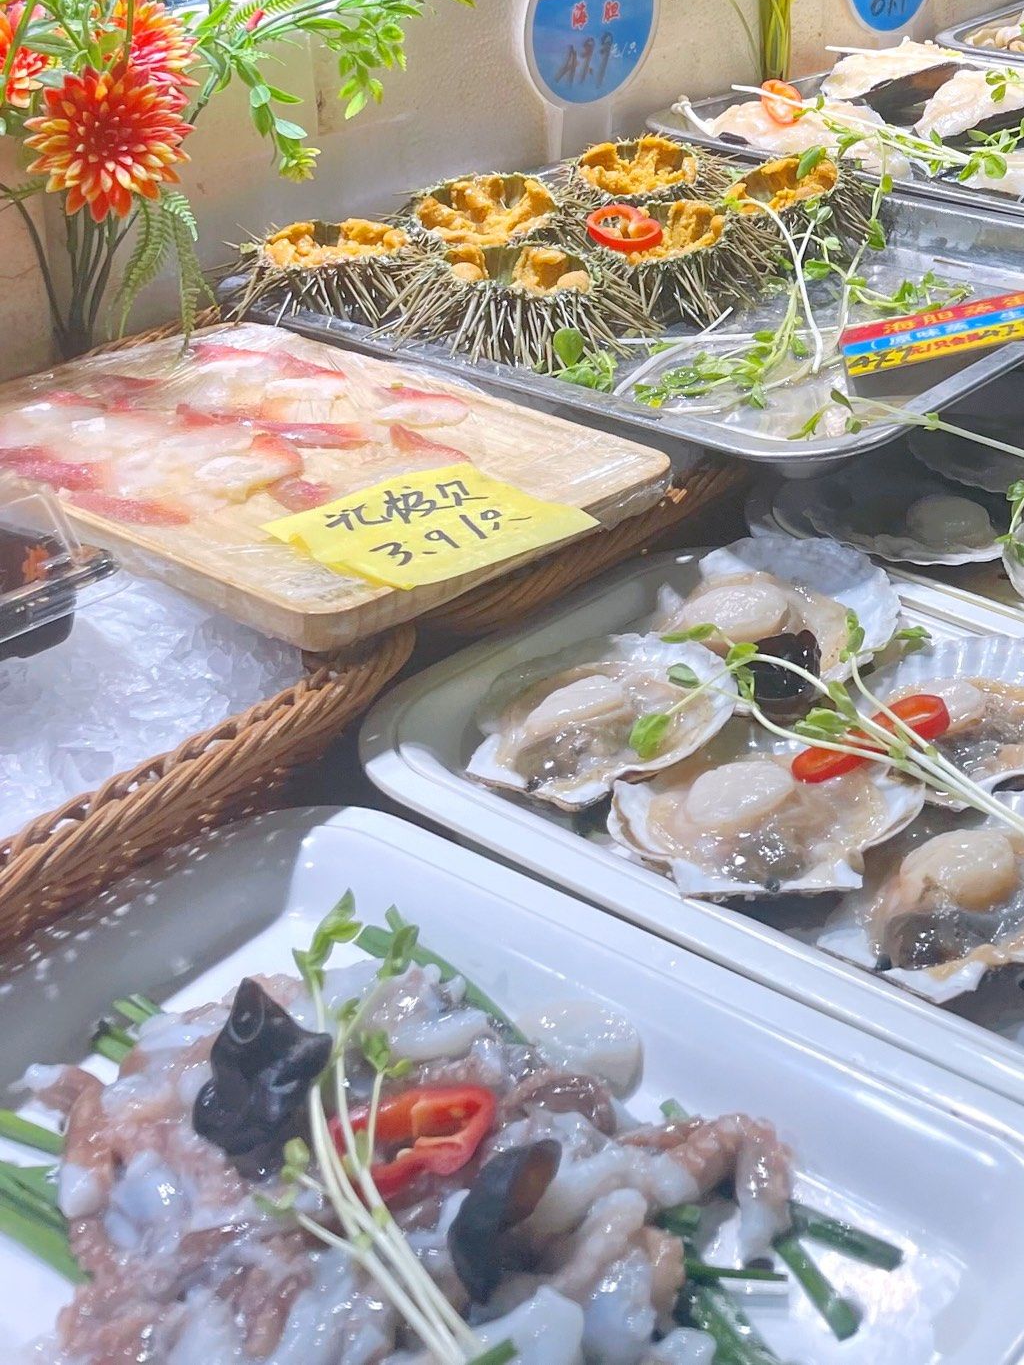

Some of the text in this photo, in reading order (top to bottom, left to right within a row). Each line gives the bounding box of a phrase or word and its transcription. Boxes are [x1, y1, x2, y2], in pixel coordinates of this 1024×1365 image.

[571, 0, 621, 30] 海胆
[323, 479, 489, 531] 北极贝
